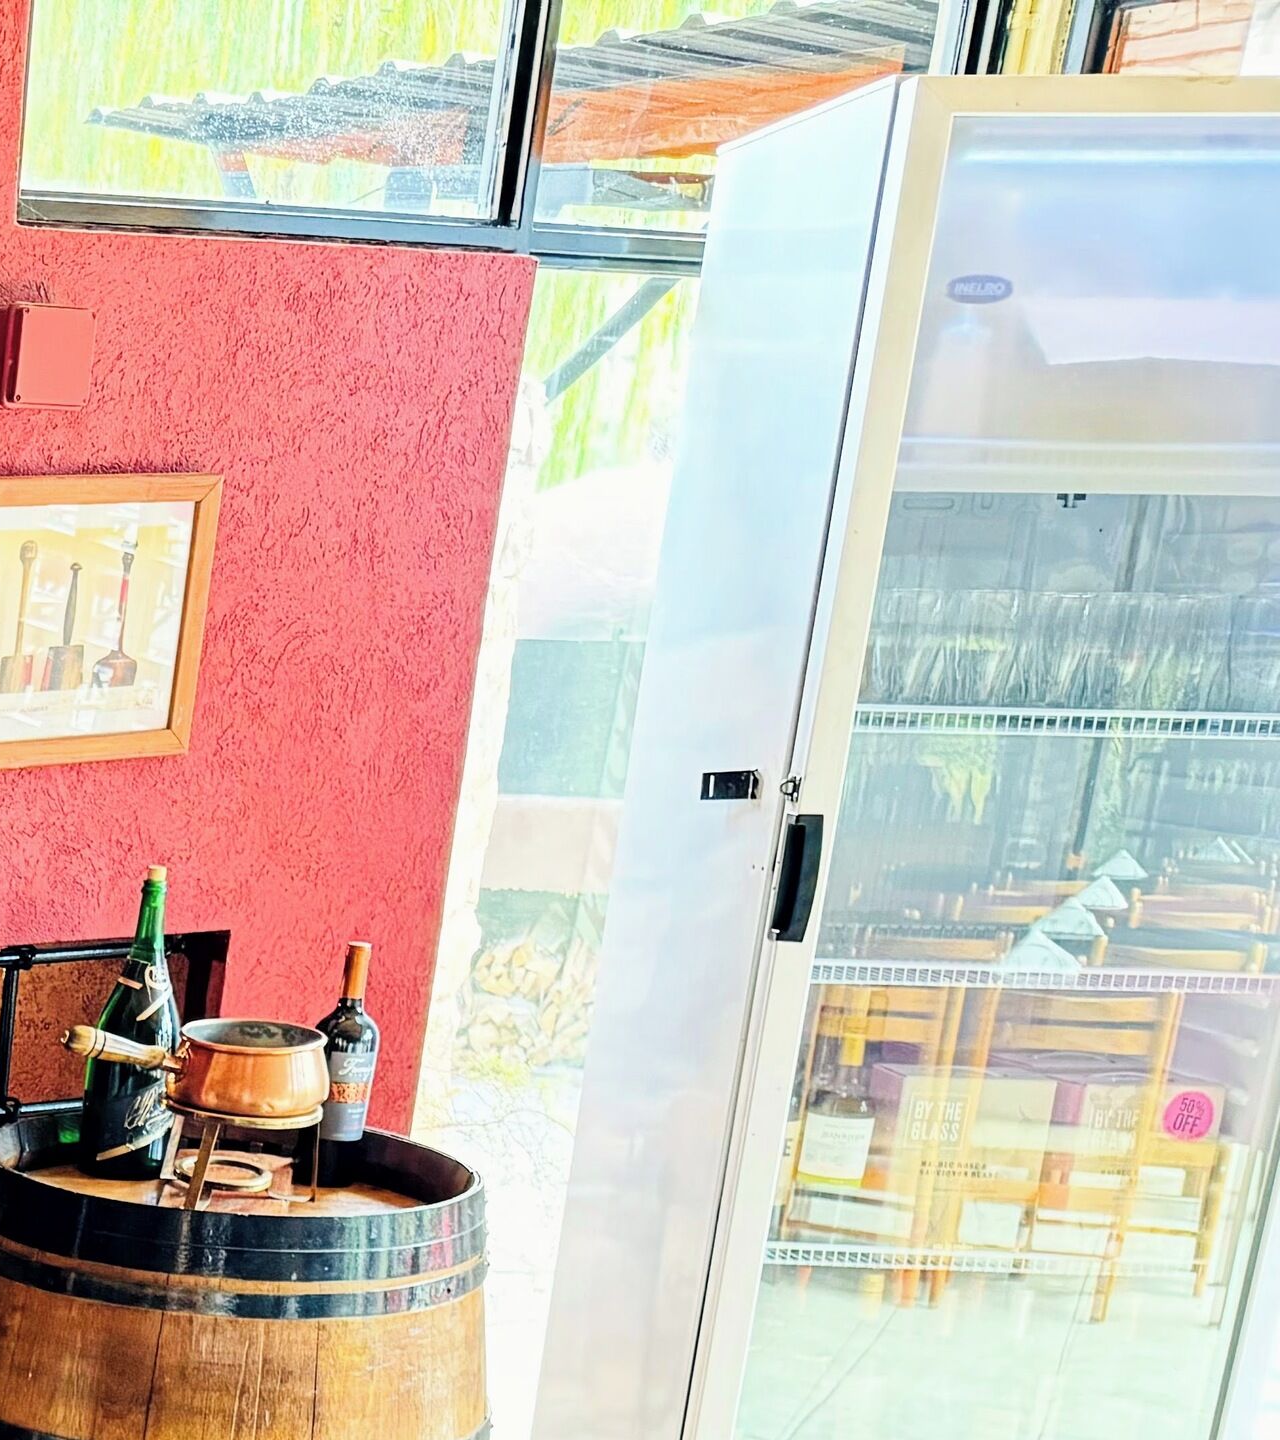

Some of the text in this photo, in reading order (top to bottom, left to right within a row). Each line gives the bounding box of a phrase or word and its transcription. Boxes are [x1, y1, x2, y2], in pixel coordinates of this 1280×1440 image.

[914, 1100, 964, 1121] BY THE
[1181, 1097, 1205, 1116] 50%
[911, 1121, 960, 1142] GLASS
[1173, 1114, 1202, 1133] OFF
